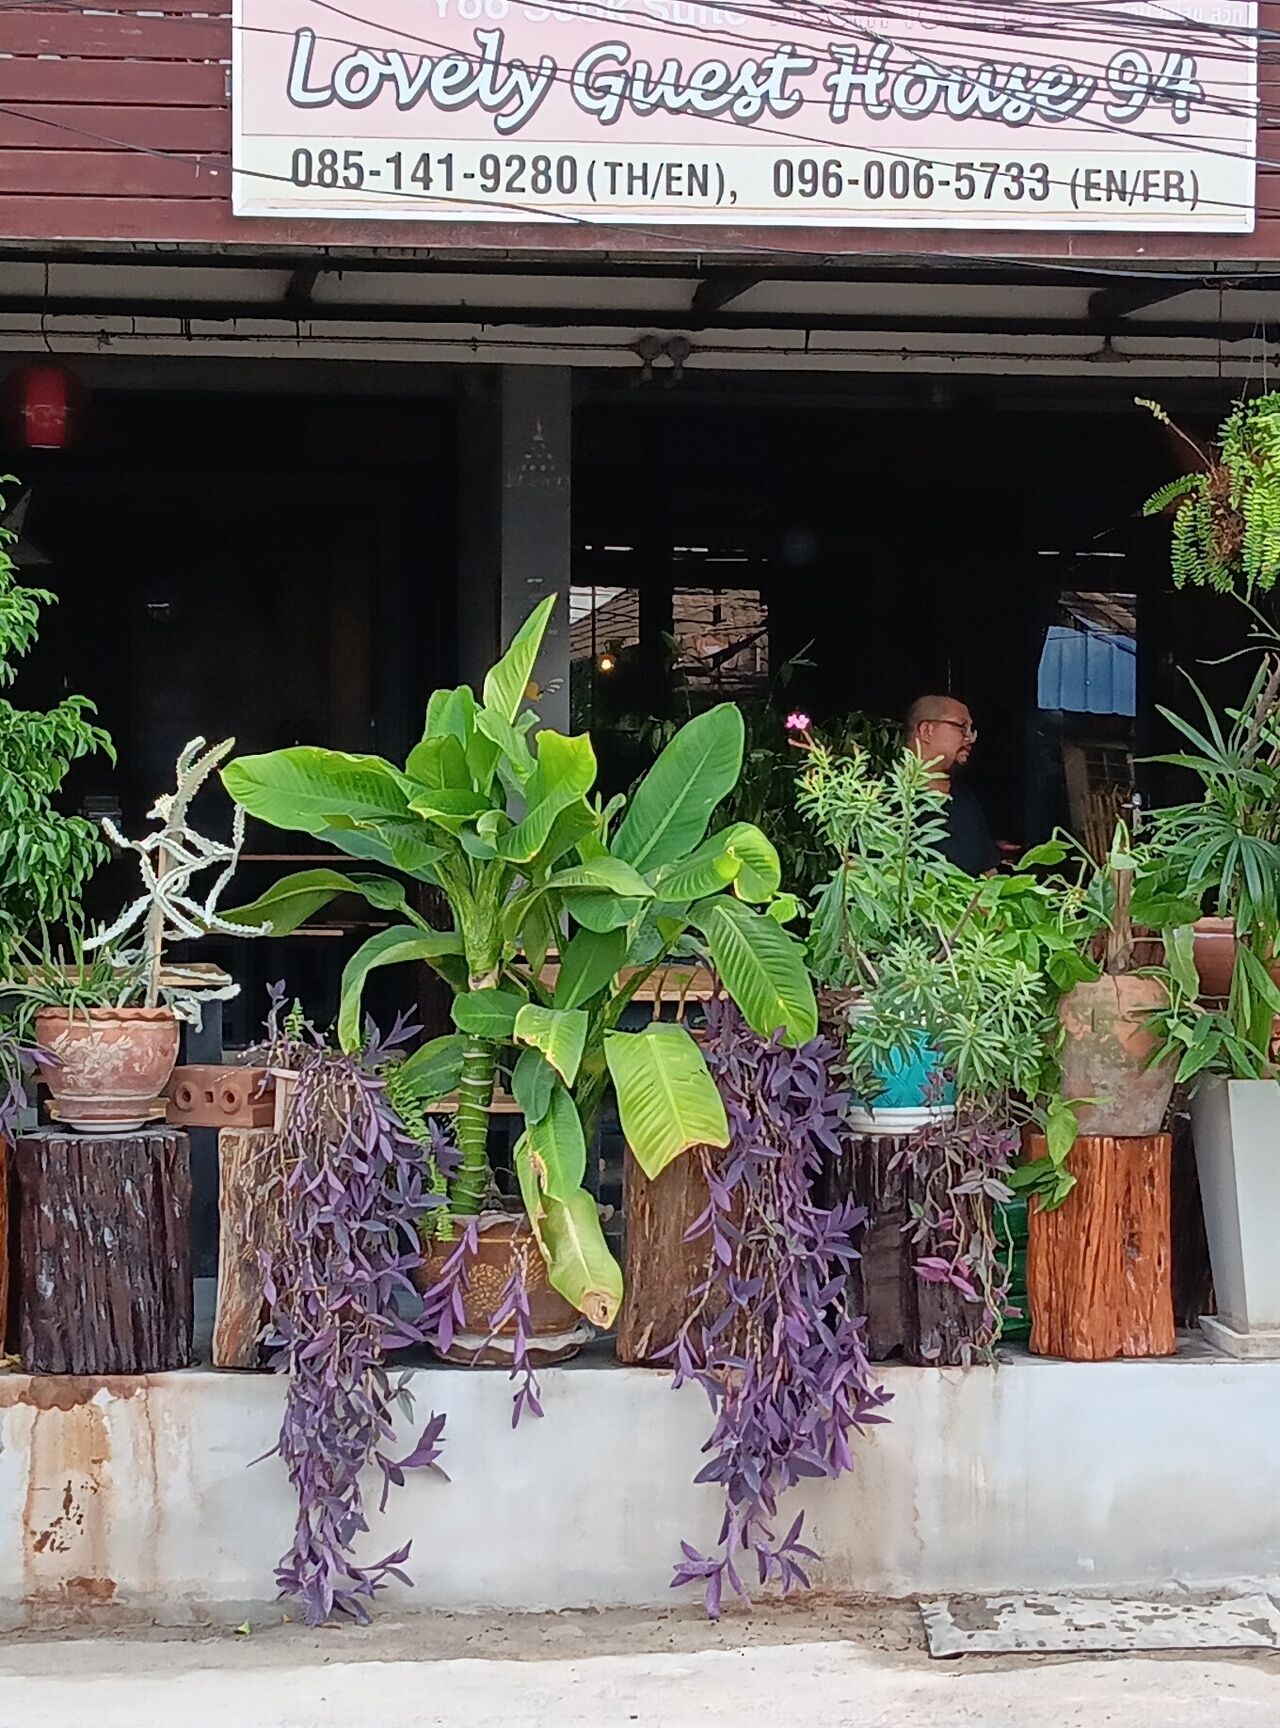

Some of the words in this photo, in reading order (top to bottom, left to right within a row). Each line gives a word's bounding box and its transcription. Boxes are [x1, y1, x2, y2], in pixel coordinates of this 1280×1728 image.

[287, 27, 556, 135] Lovely
[571, 39, 817, 127] Guest
[824, 41, 1098, 128] House
[1104, 48, 1207, 125] 94
[773, 158, 1050, 202] 096-006-5733
[1070, 167, 1199, 212] (EN/FR)
